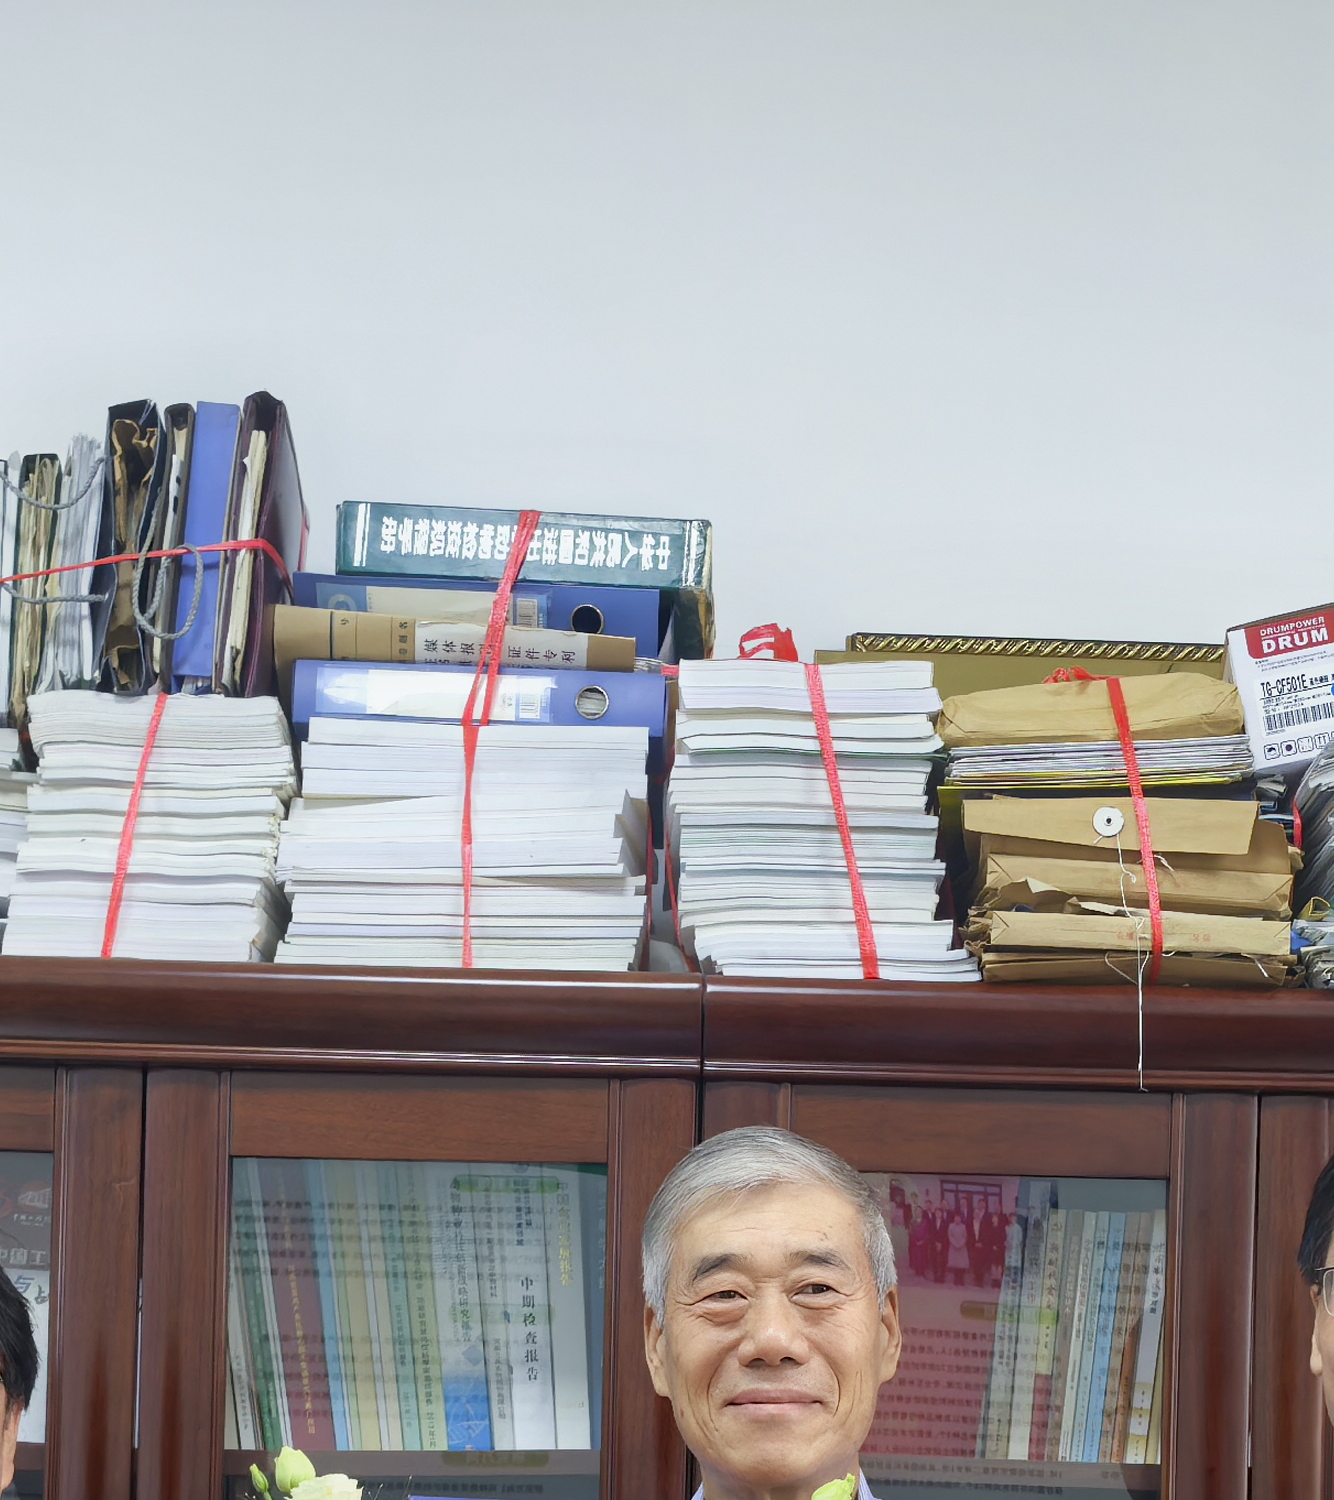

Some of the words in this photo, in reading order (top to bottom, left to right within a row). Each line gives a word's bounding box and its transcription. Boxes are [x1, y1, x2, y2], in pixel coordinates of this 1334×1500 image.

[381, 516, 670, 571] 中华人民共和国进出动物检疫规程手册
[1260, 616, 1325, 636] DRUMPOWER
[1262, 627, 1328, 654] DRUM
[1260, 674, 1308, 697] TG-CF501E
[520, 1276, 540, 1381] 中期检查报告
